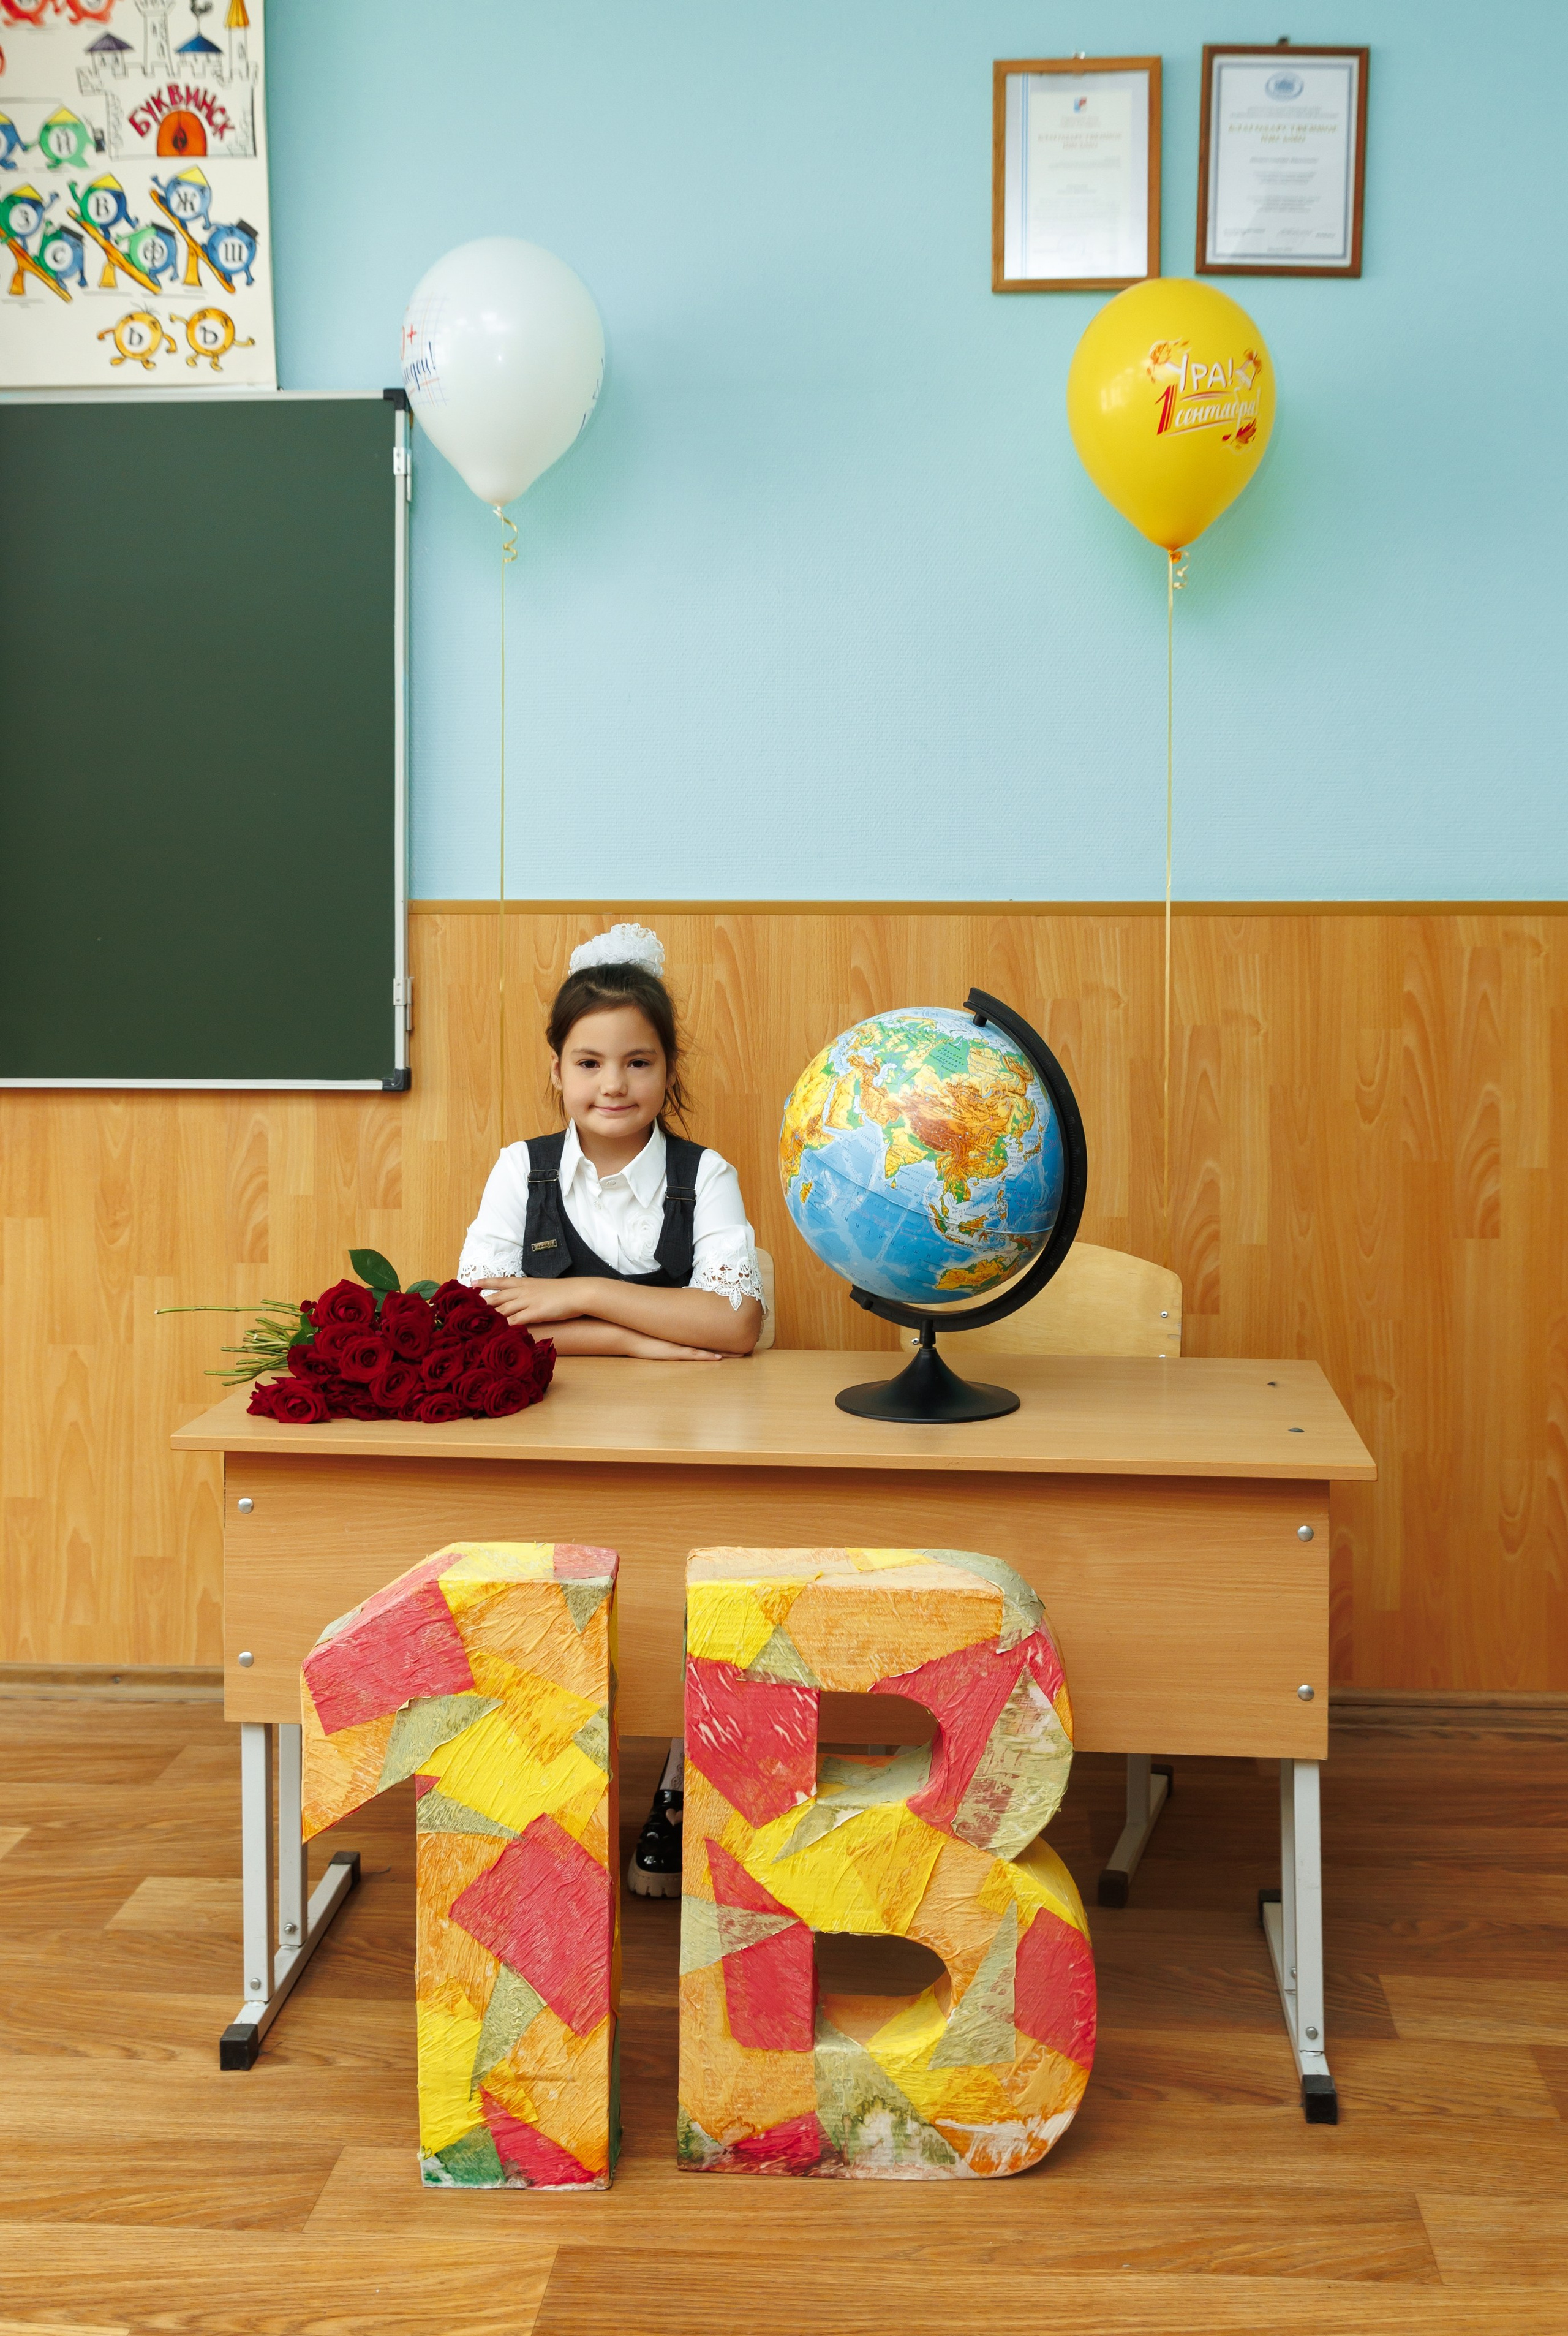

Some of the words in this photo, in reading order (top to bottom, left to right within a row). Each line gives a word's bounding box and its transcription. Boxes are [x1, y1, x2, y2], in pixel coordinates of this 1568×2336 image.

[127, 82, 235, 140] БУКВИНСК
[94, 195, 110, 217] В
[174, 189, 196, 212] Ж
[17, 208, 30, 229] З
[52, 245, 66, 265] С
[143, 238, 164, 268] Ф
[224, 241, 244, 262] Ш
[1165, 353, 1234, 394] УРА!
[1155, 384, 1178, 436] 1
